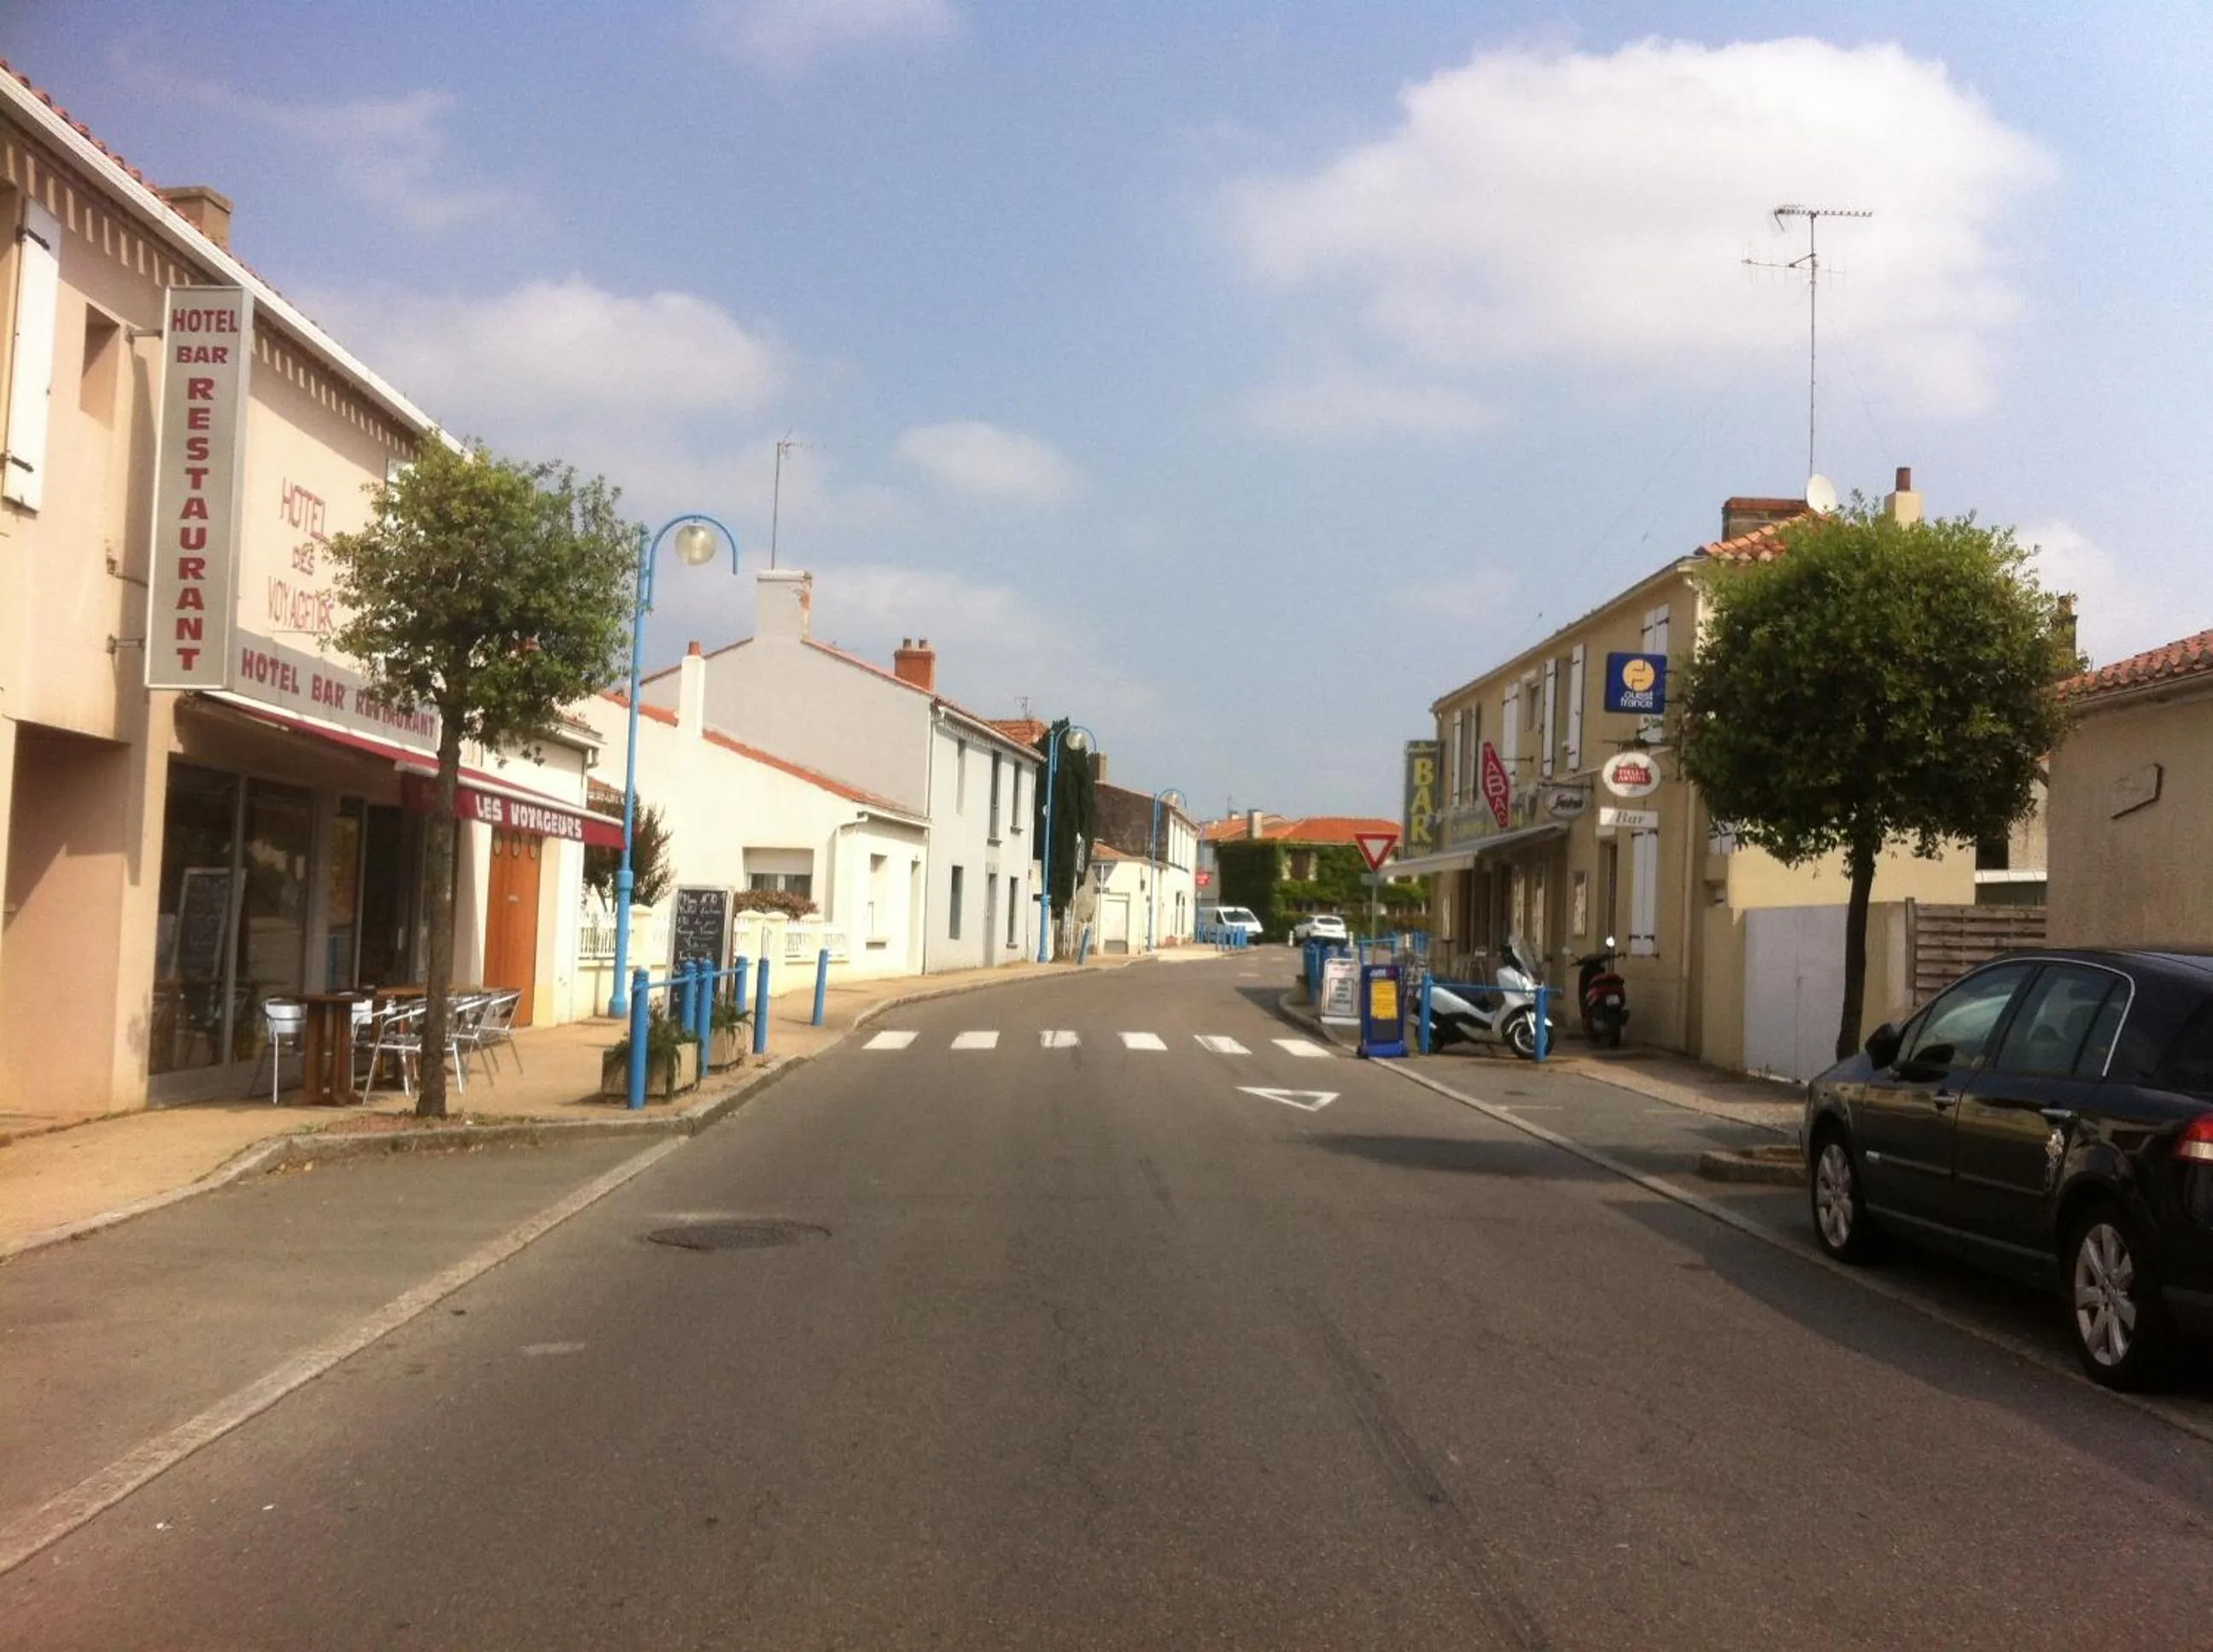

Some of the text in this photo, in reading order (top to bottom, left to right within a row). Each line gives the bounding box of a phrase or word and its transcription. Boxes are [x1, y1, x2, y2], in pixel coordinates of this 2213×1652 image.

[172, 309, 238, 333] HOTEL
[176, 346, 229, 364] BAR
[175, 377, 214, 671] RESTAURANT
[279, 476, 328, 543] HOTEL
[241, 647, 300, 695] HOTEL
[311, 673, 347, 710] BAR
[1620, 696, 1654, 709] france
[1410, 757, 1434, 844] BAR
[1486, 745, 1507, 826] TABAC
[476, 793, 583, 838] LES VOYAGEURS
[1614, 810, 1645, 826] Bar
